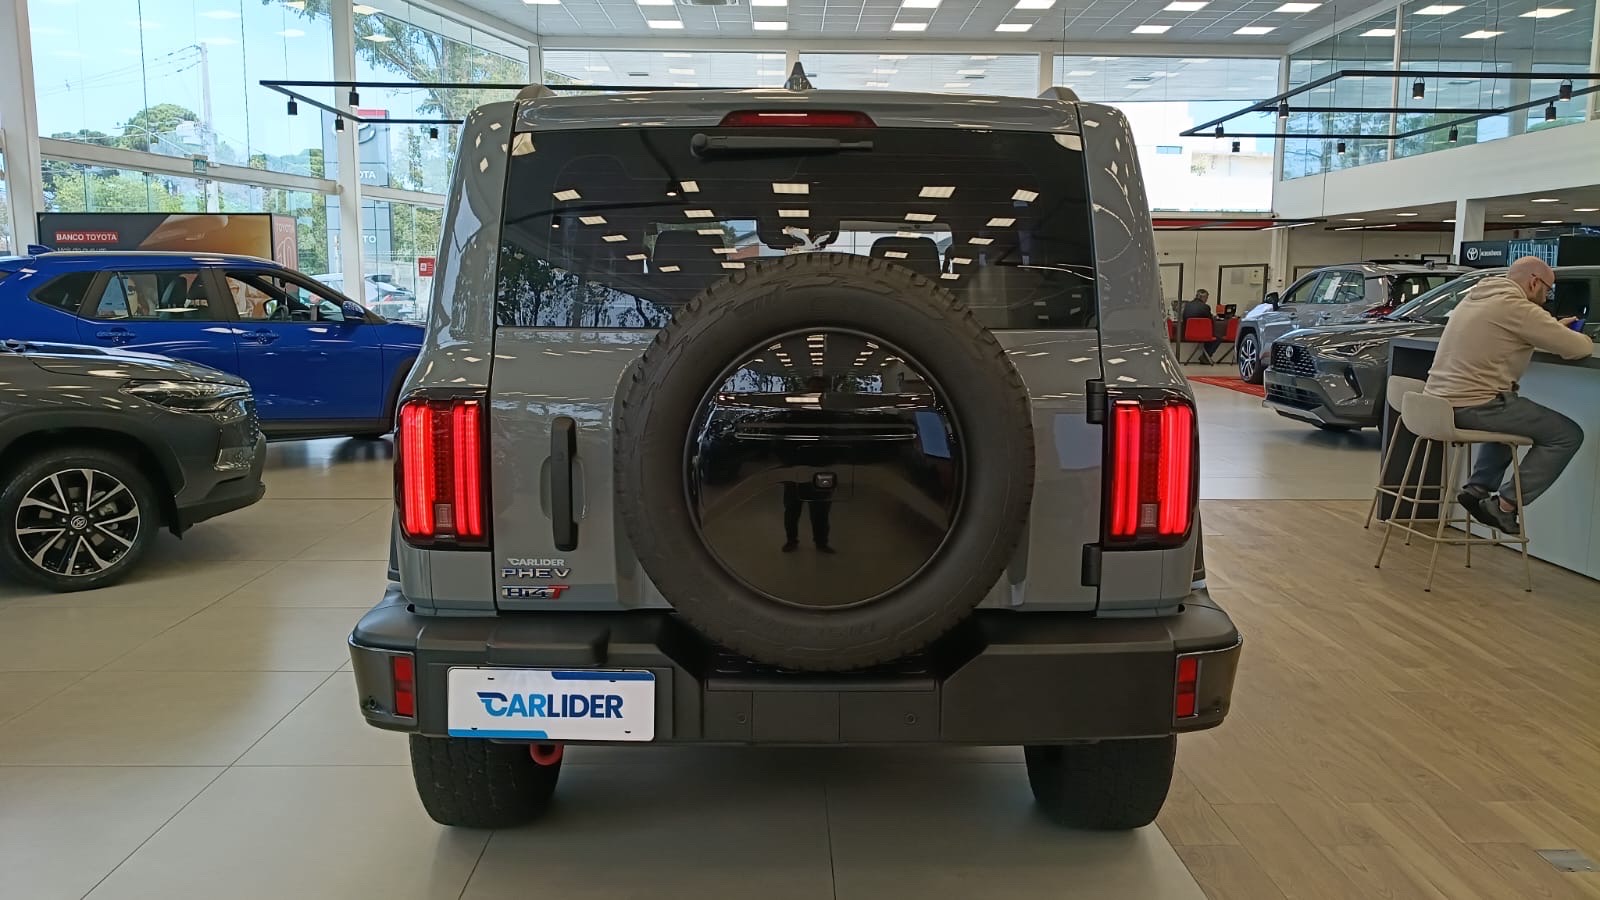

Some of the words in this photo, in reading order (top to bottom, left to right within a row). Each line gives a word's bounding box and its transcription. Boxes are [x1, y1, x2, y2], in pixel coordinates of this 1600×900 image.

[56, 233, 84, 241] BANCO
[85, 233, 117, 241] TOYOTA
[507, 558, 565, 566] CARLIDER
[501, 567, 571, 578] PHEV
[476, 691, 624, 719] CARLIDER
